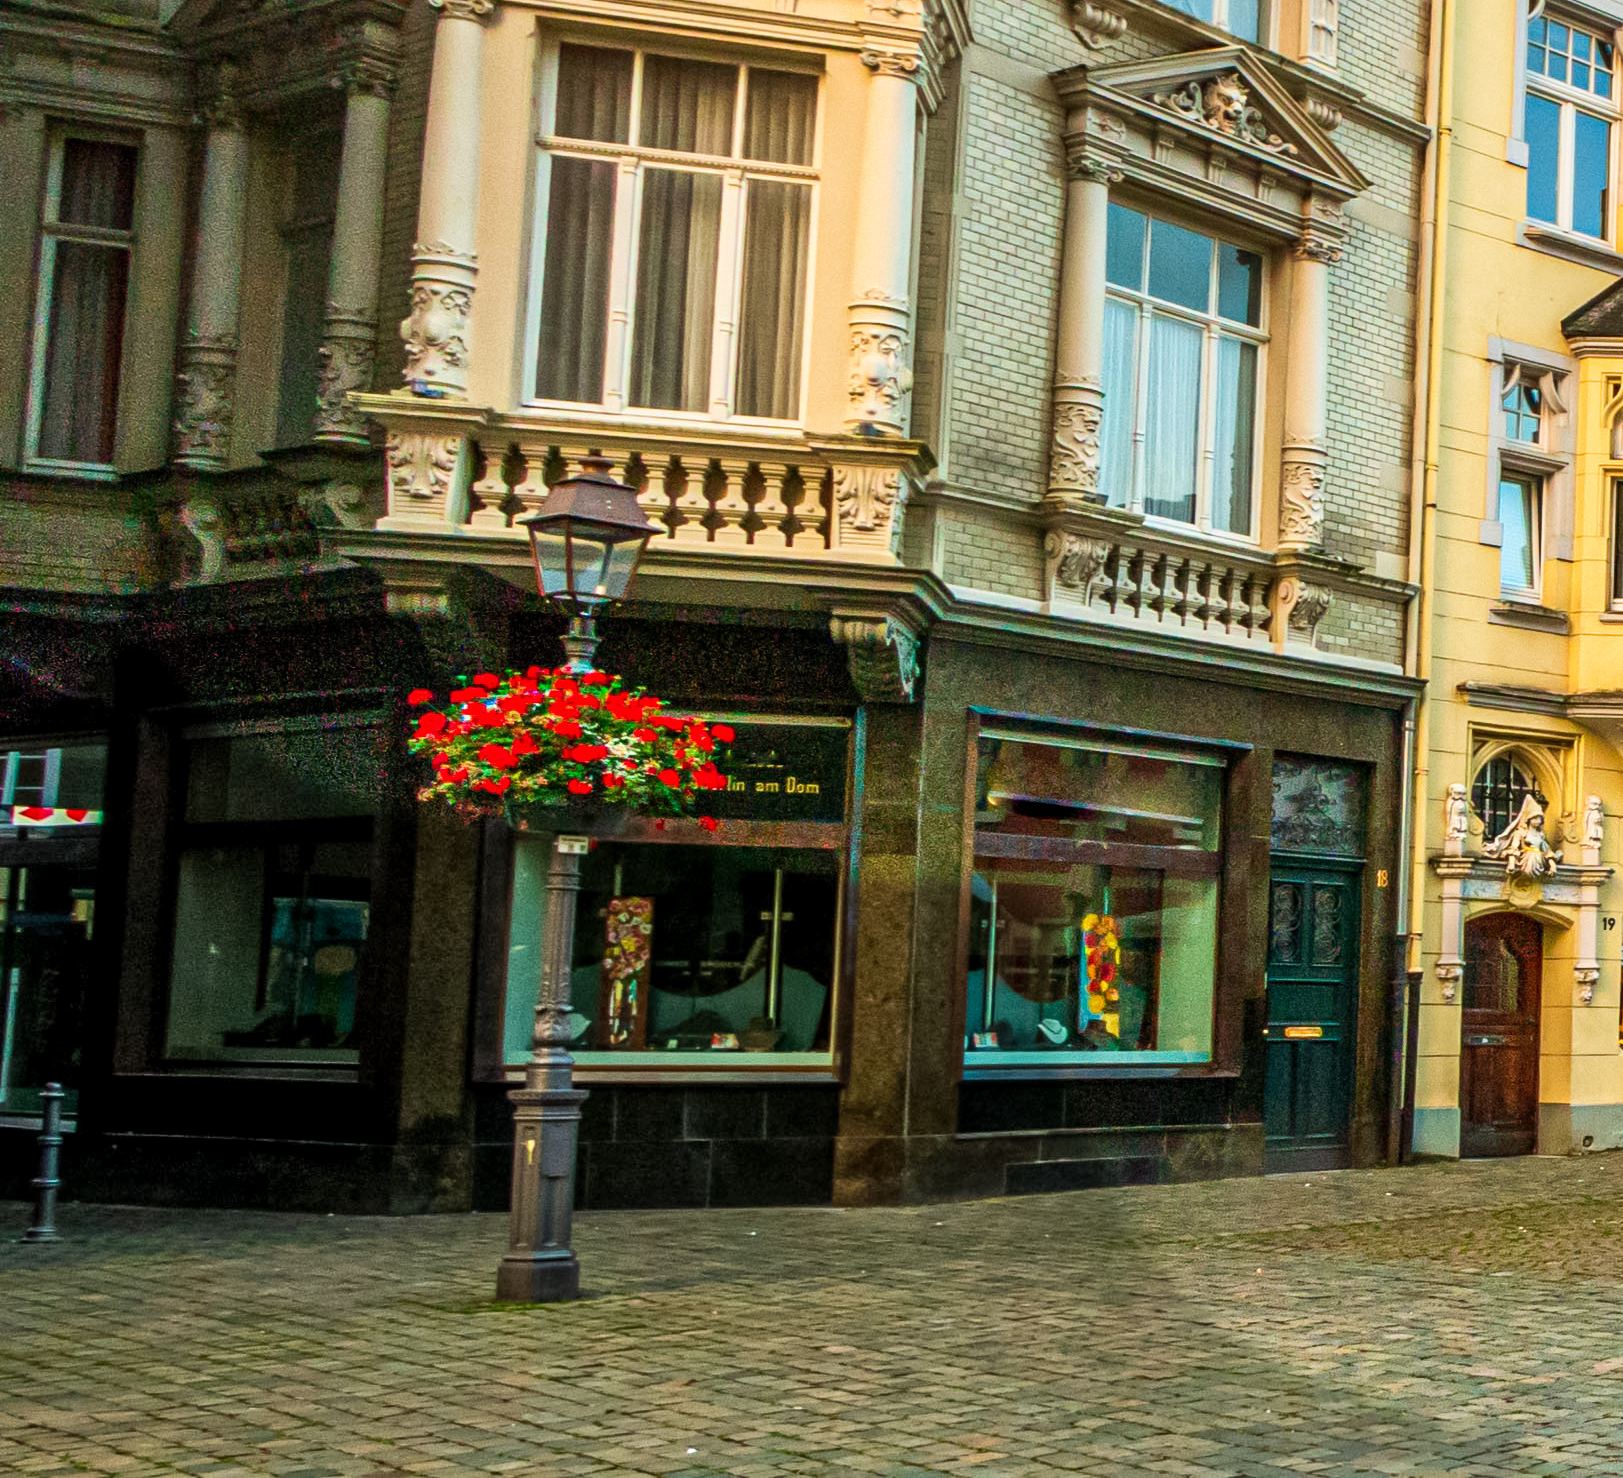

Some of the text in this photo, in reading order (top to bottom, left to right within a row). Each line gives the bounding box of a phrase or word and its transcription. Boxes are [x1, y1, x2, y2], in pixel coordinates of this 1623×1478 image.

[755, 781, 779, 793] am
[785, 776, 820, 794] Dom
[1376, 869, 1389, 888] 18
[1602, 917, 1616, 931] 19
